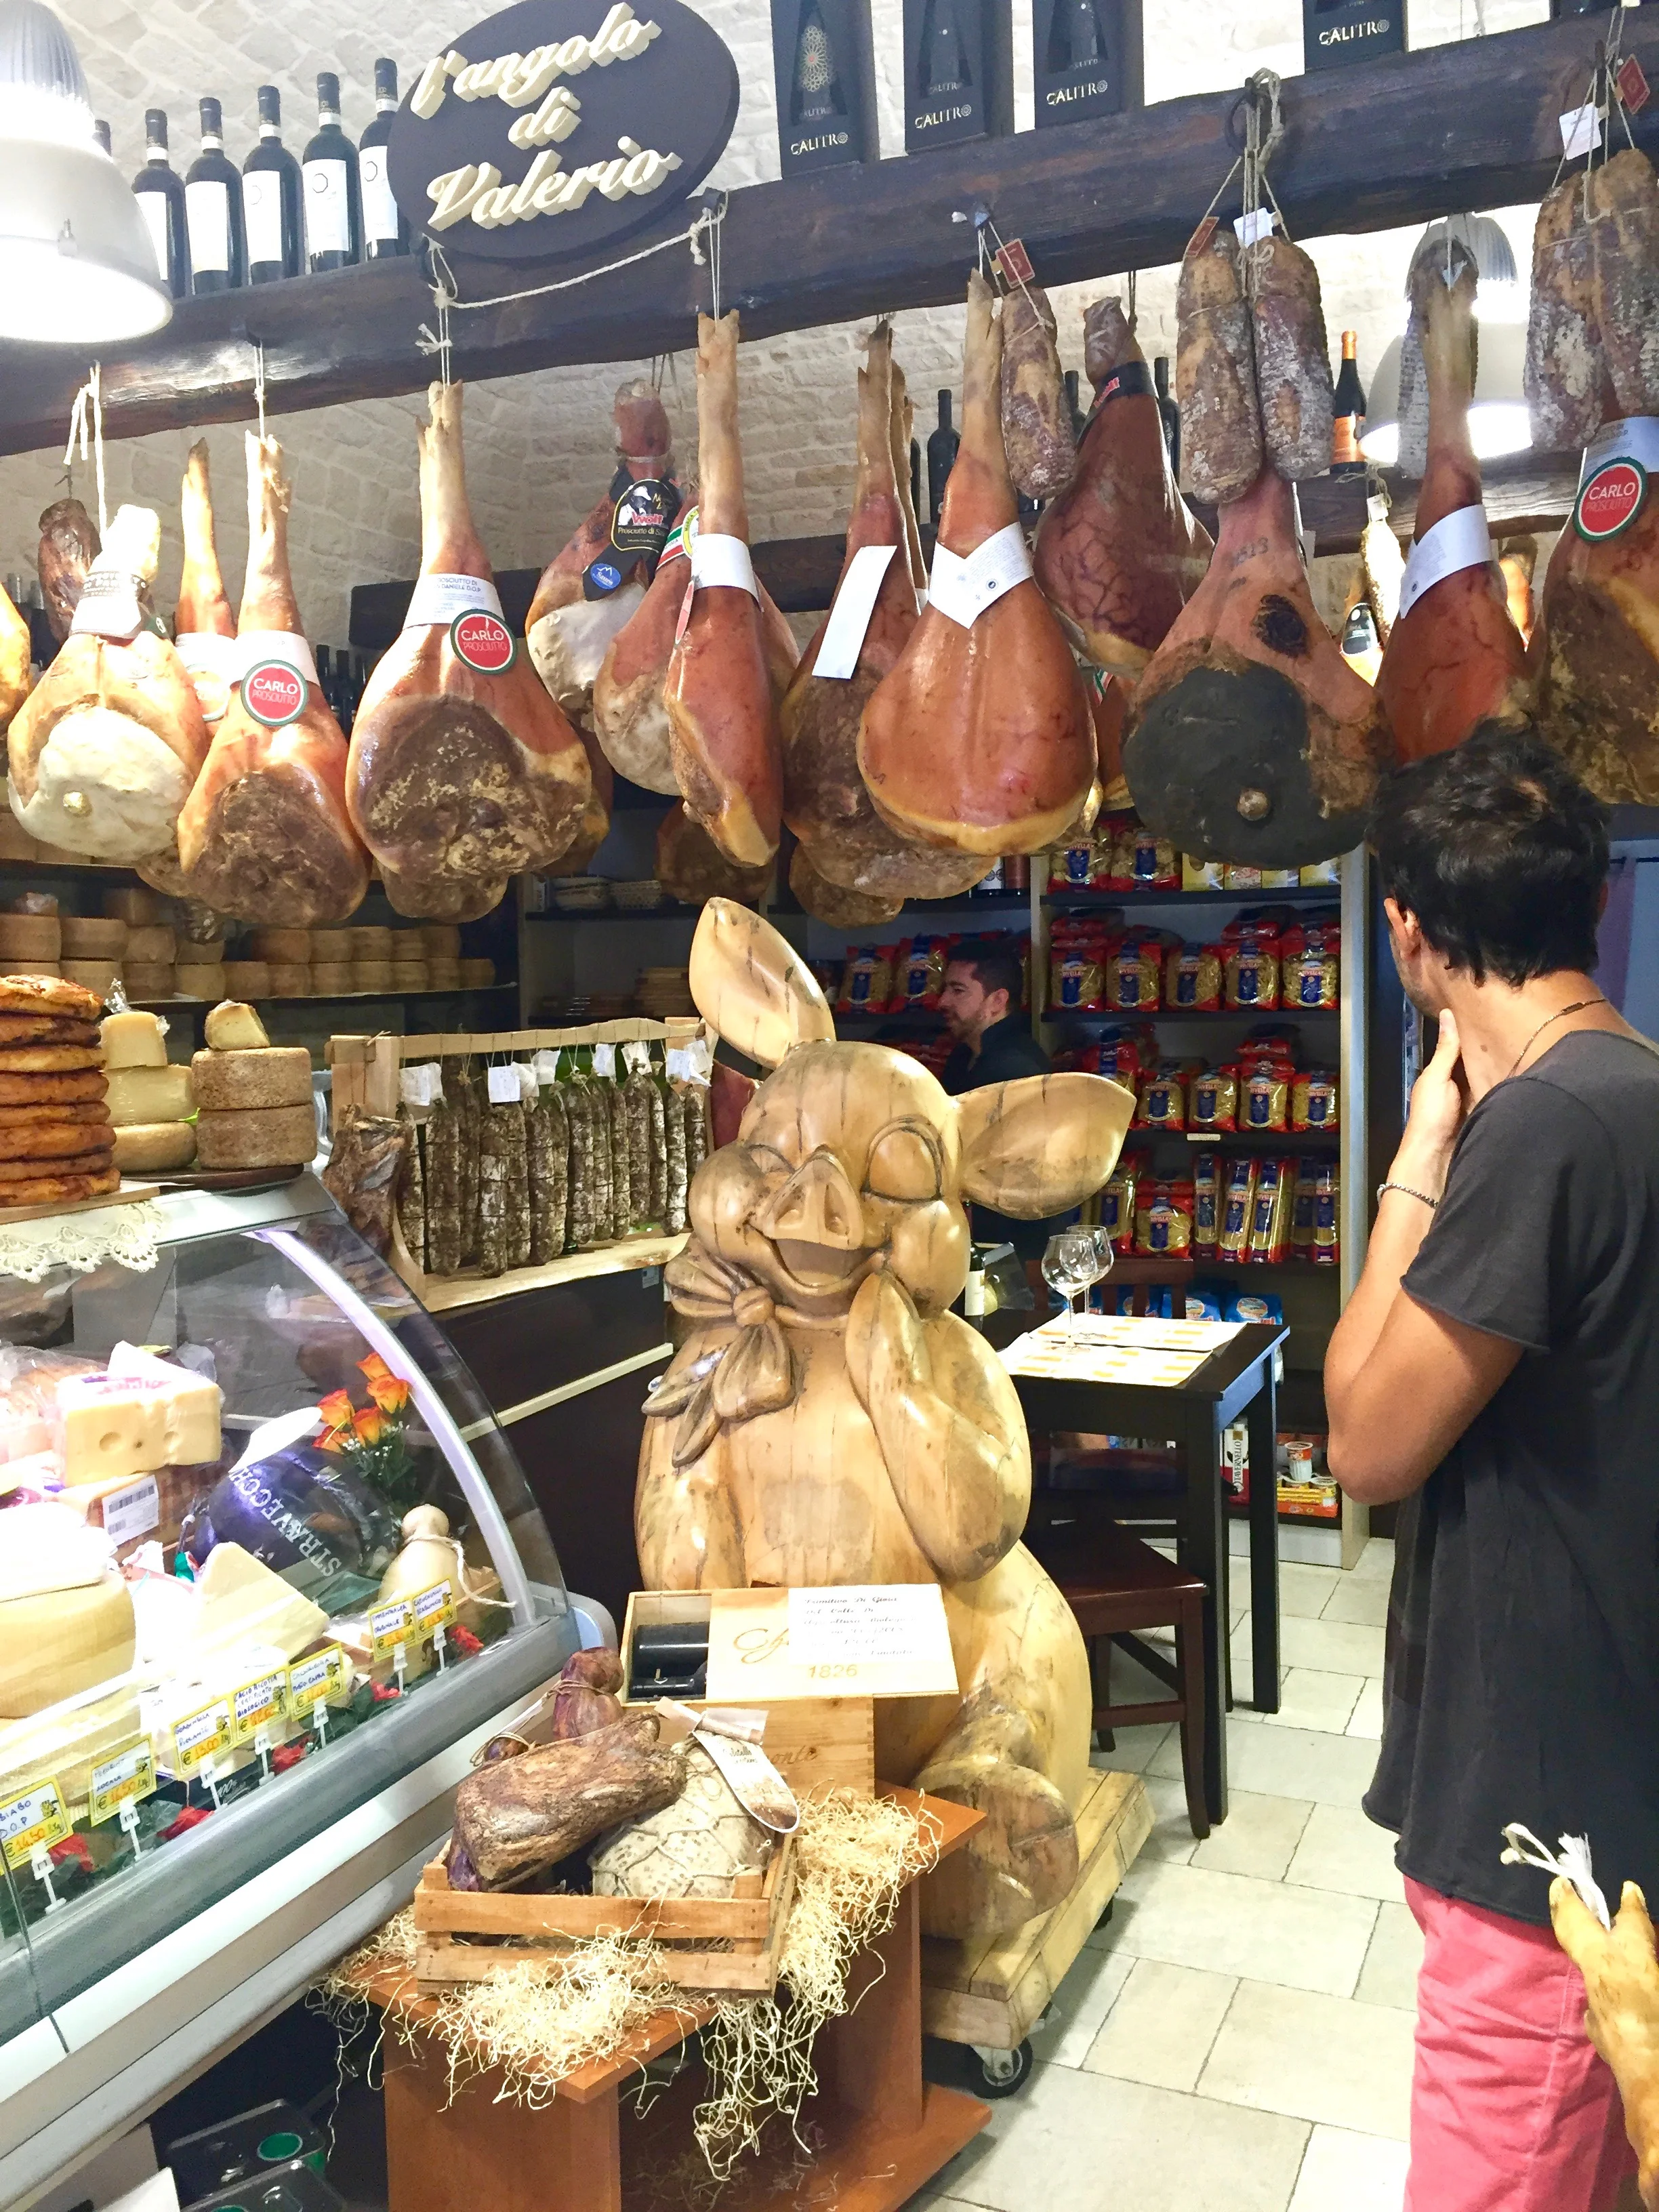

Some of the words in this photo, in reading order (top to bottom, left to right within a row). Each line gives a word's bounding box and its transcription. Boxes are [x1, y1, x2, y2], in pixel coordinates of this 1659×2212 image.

[508, 85, 582, 150] di
[426, 136, 684, 231] Valerio
[1589, 482, 1636, 500] CARLO
[461, 630, 504, 641] CARLO
[253, 678, 298, 695] CARLO
[1232, 1441, 1242, 1484] TAVERNELLO
[808, 1664, 858, 1679] 1826
